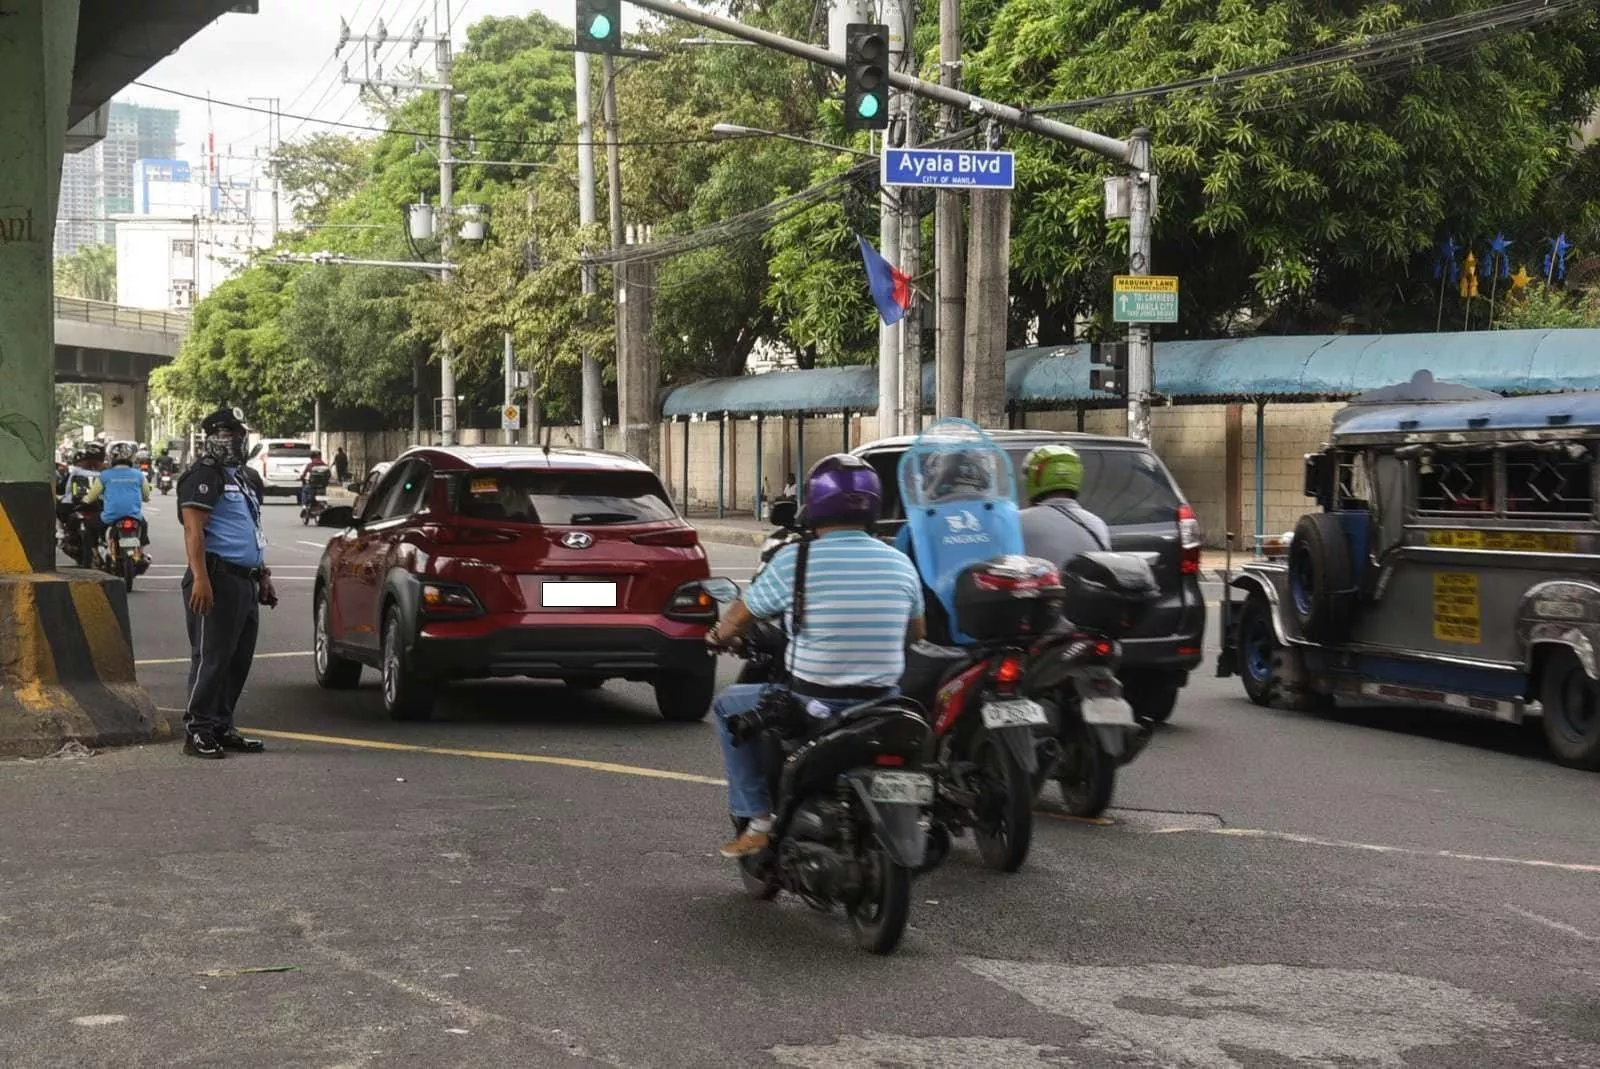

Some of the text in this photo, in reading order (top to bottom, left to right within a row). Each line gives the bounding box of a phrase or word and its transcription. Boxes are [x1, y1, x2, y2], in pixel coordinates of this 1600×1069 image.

[899, 152, 1000, 176] Ayala Blvd
[922, 175, 977, 185] CITY OF MANILA
